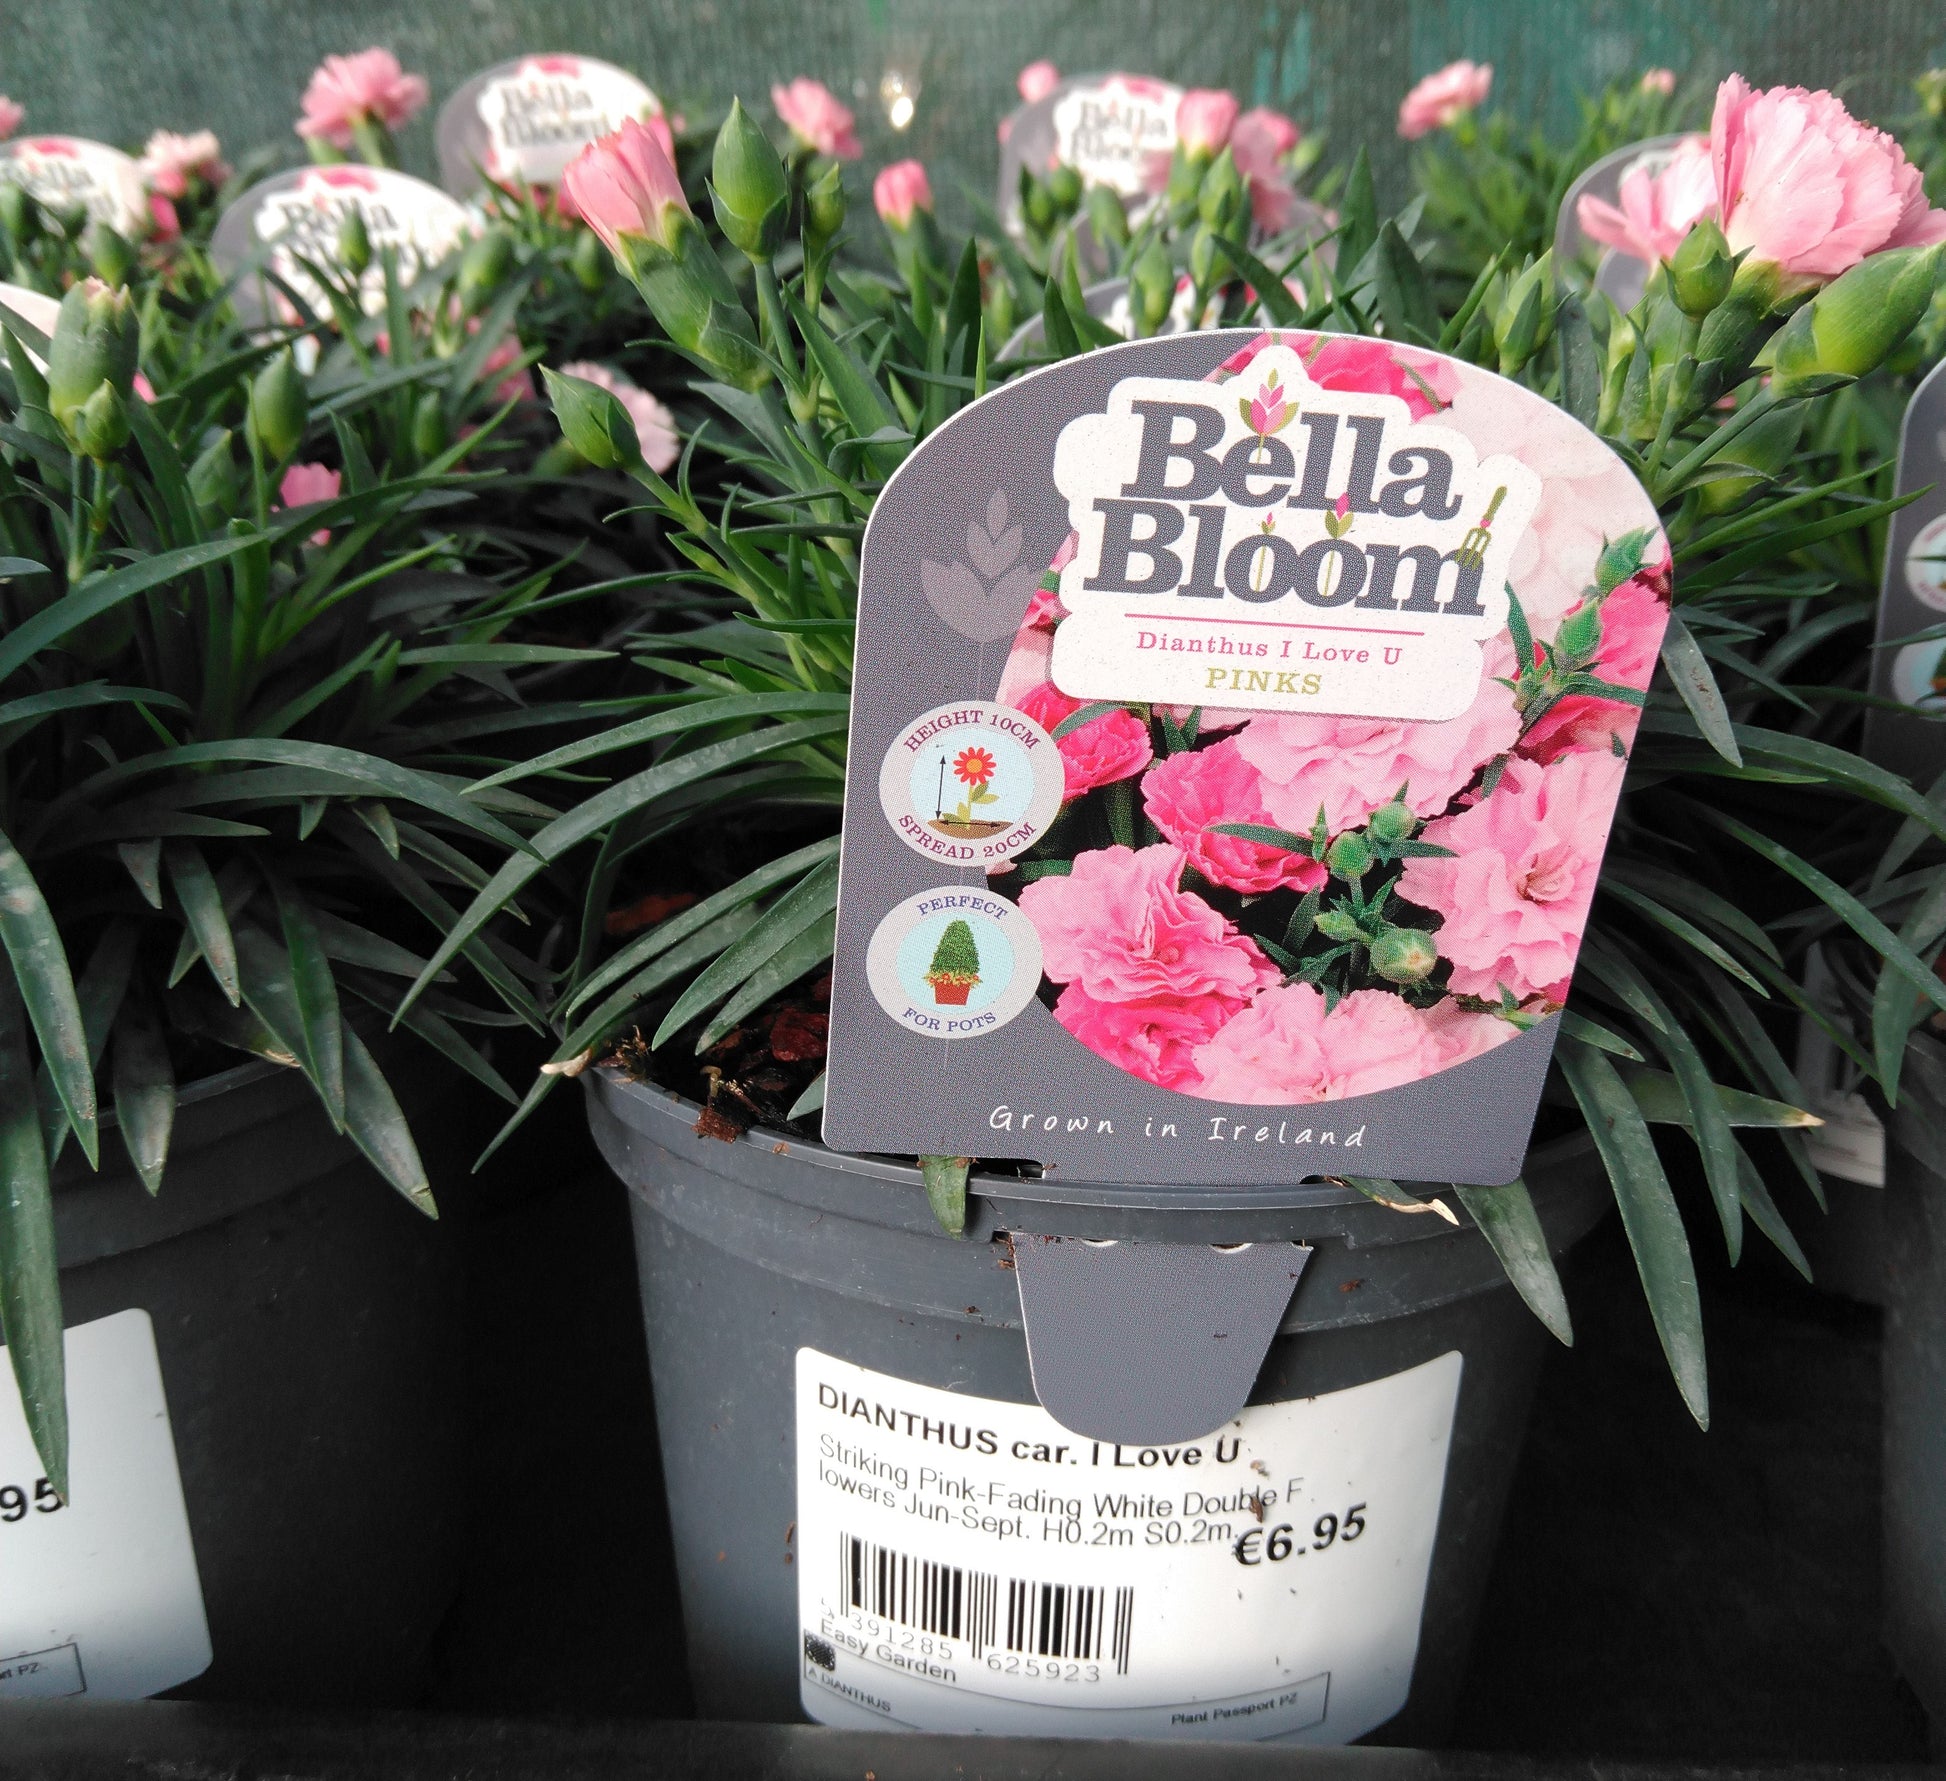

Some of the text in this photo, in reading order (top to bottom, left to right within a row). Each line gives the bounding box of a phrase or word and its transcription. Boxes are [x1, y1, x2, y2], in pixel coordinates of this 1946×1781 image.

[1120, 398, 1463, 521] Bella
[1082, 497, 1486, 617] Bloom
[1136, 631, 1404, 666] Dianthus I Love U
[1204, 667, 1323, 696] PINKS
[903, 710, 1041, 753] HEIGHT 10CM
[898, 814, 1037, 860] SPREAD 20CM
[916, 895, 1009, 921] PERFECT
[901, 1006, 997, 1033] FOR POTS
[989, 1105, 1368, 1148] Grown in Ireland
[818, 1382, 1241, 1467] DIANTHUS car. I Love U
[819, 1433, 1304, 1519] Striking Pink-Fading White Double F
[819, 1459, 896, 1509] lowers
[904, 1493, 1030, 1541] Jun-Sept.
[1043, 1517, 1134, 1546] H0.2m
[1231, 1501, 1367, 1566] €6.95
[820, 1618, 958, 1684] Easy Garden
[850, 1611, 954, 1661] 391285
[987, 1653, 1101, 1683] 625923
[820, 1673, 892, 1714] DIANTHUS
[1171, 1711, 1209, 1726] Plant
[1213, 1698, 1275, 1720] Passport
